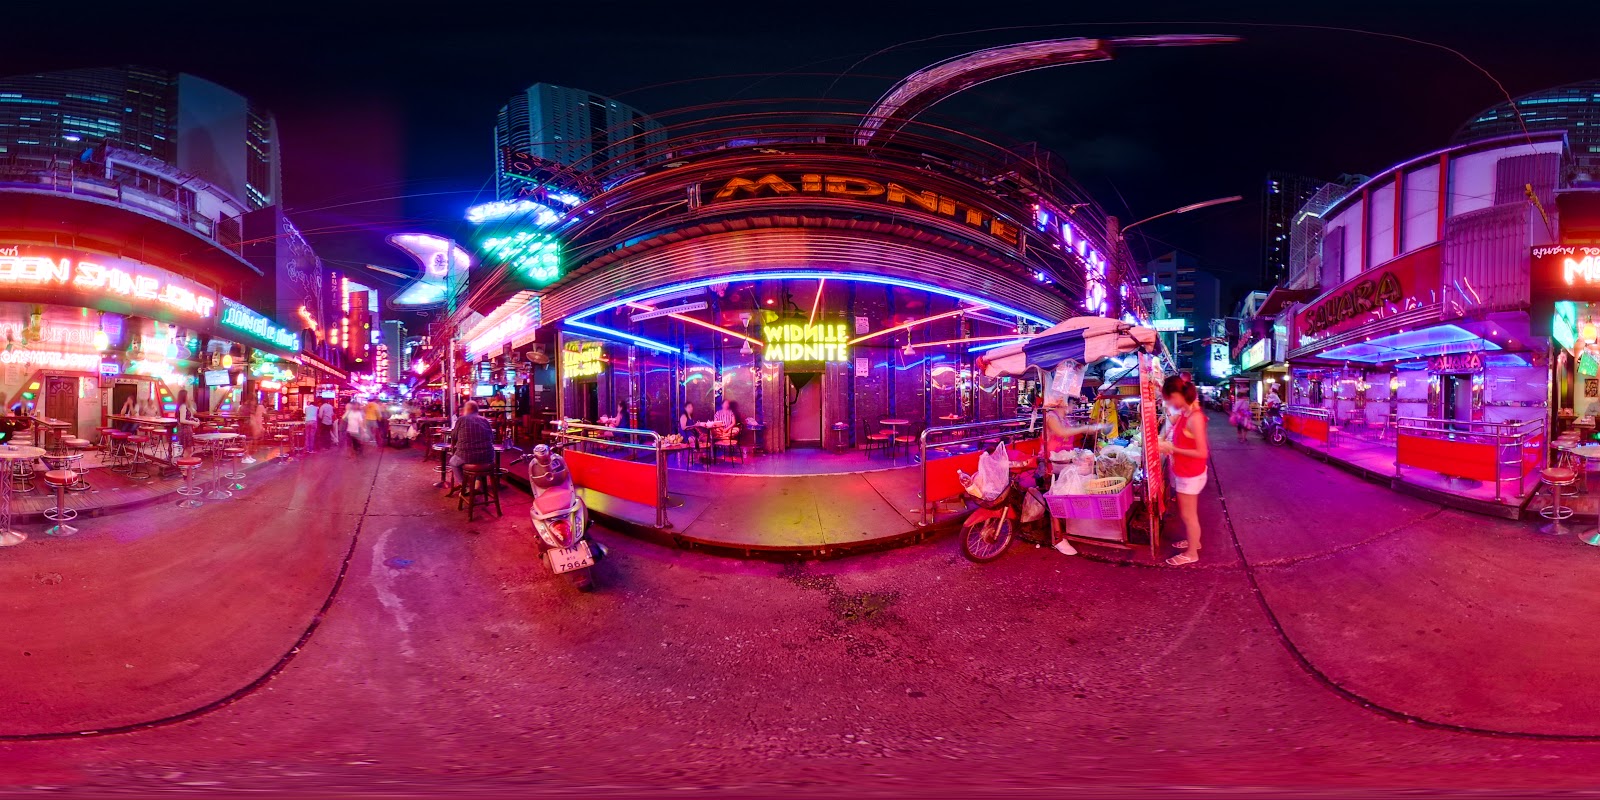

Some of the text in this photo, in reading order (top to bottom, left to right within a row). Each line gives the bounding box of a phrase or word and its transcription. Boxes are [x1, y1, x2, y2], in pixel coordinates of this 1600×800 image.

[714, 173, 1018, 245] MIDNITE
[764, 343, 847, 361] MIDNITE
[560, 559, 587, 571] 7964
